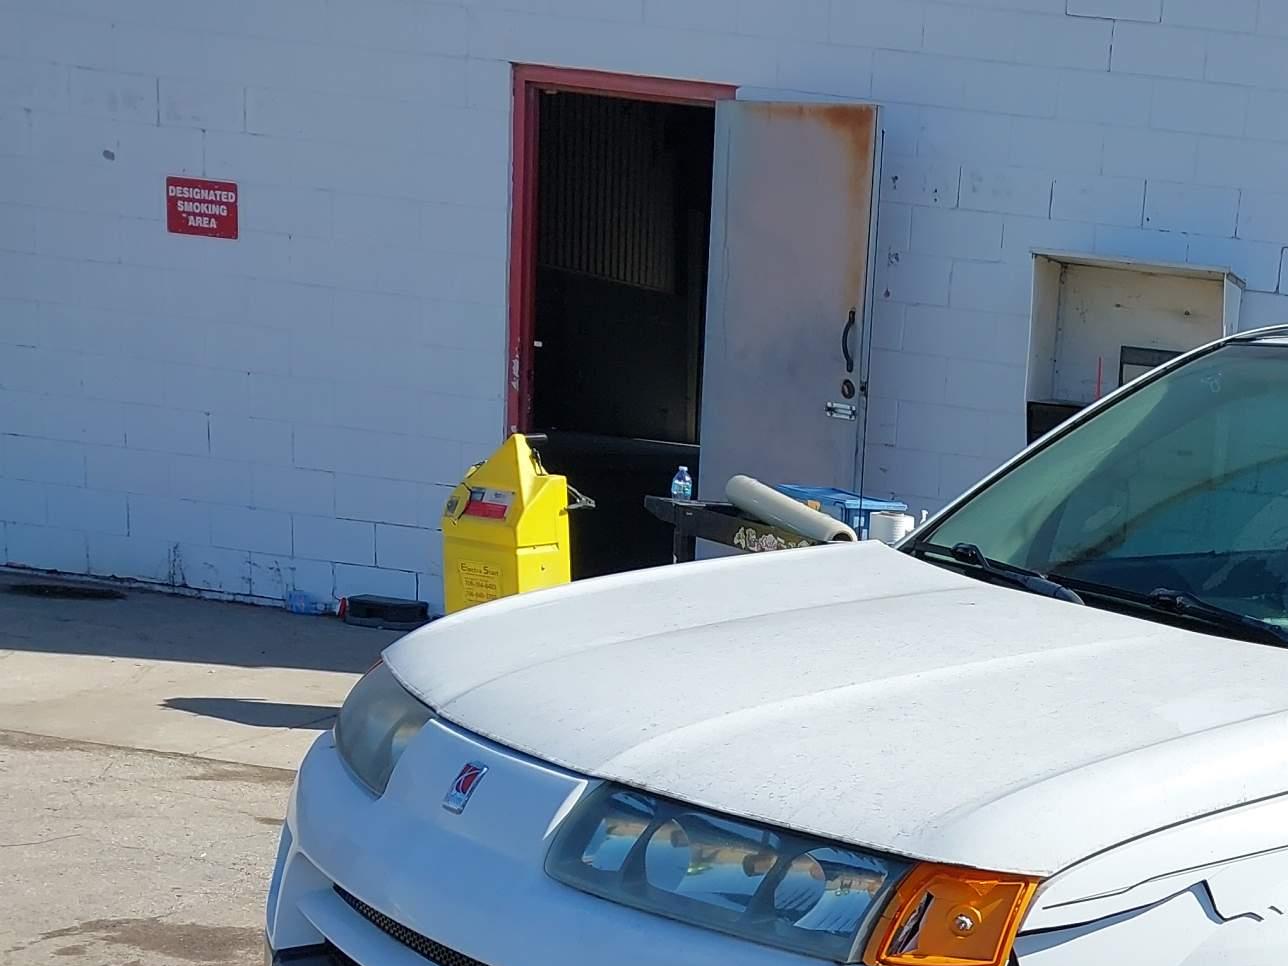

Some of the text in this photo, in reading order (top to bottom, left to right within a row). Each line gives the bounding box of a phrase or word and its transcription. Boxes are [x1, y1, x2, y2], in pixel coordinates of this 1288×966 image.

[168, 185, 236, 203] DESIGNATED
[177, 200, 228, 216] SMOKING
[188, 216, 217, 229] AREA
